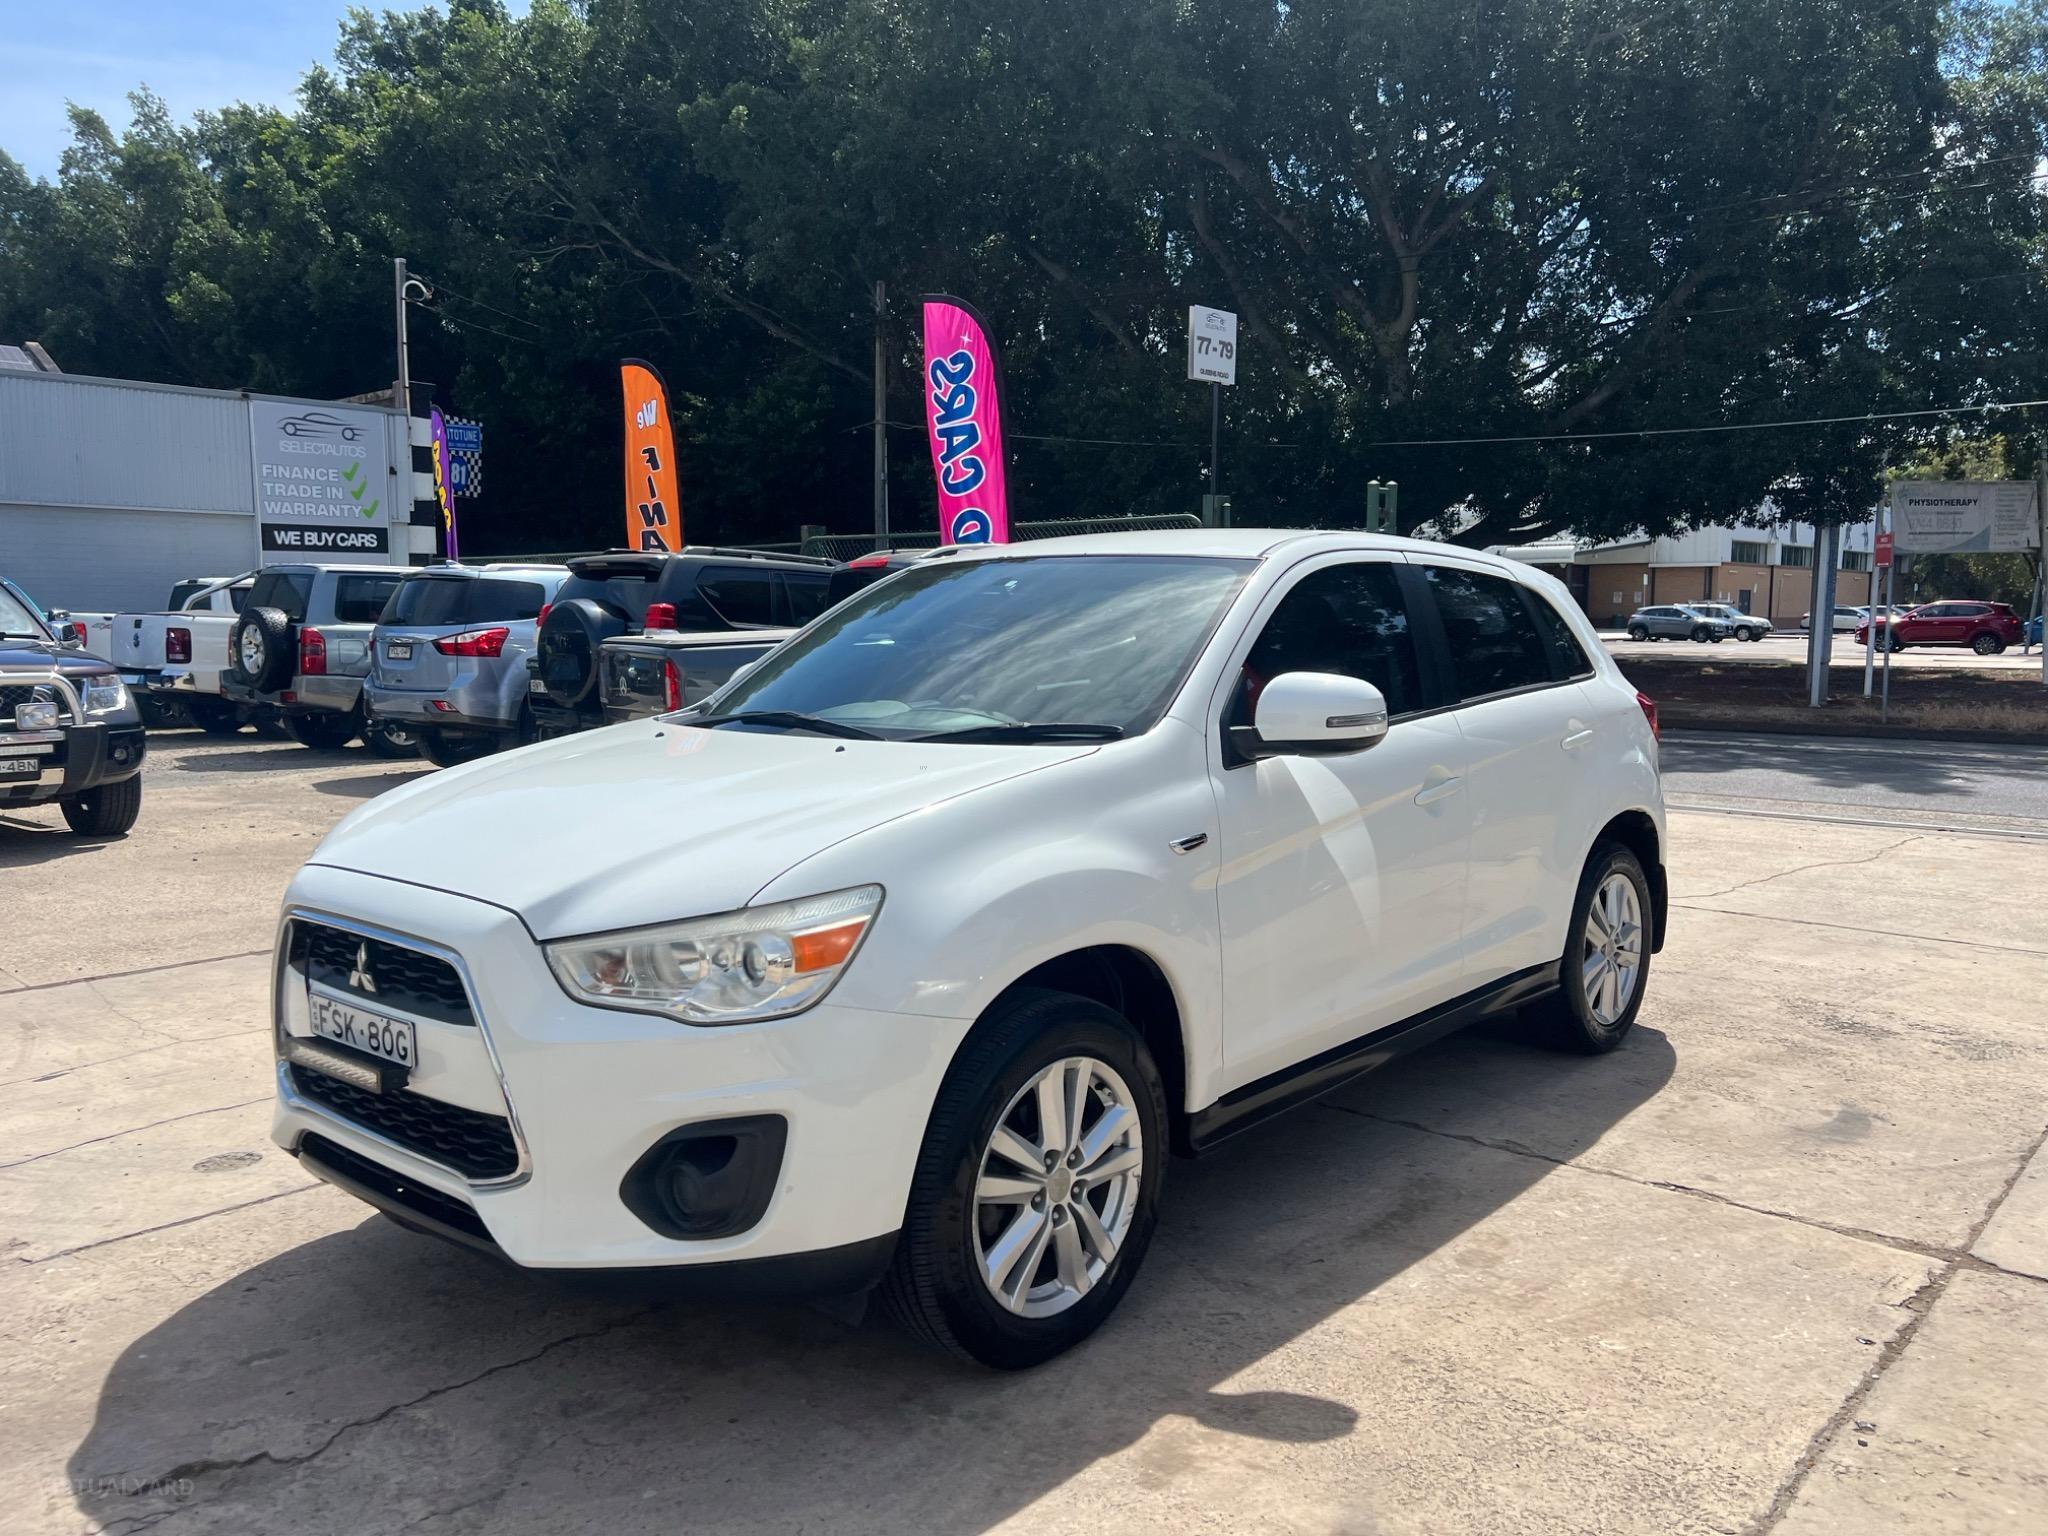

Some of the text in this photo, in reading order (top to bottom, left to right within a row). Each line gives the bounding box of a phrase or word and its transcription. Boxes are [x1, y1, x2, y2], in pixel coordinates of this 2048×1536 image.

[448, 429, 479, 441] TOTUNE
[262, 464, 339, 482] FINANCE
[451, 462, 467, 485] 81
[263, 483, 343, 500] TRADE IN
[264, 501, 362, 518] WARRANTY
[1908, 499, 1979, 508] PHYSIOTHERAPY
[274, 530, 378, 548] WE BUY CARS
